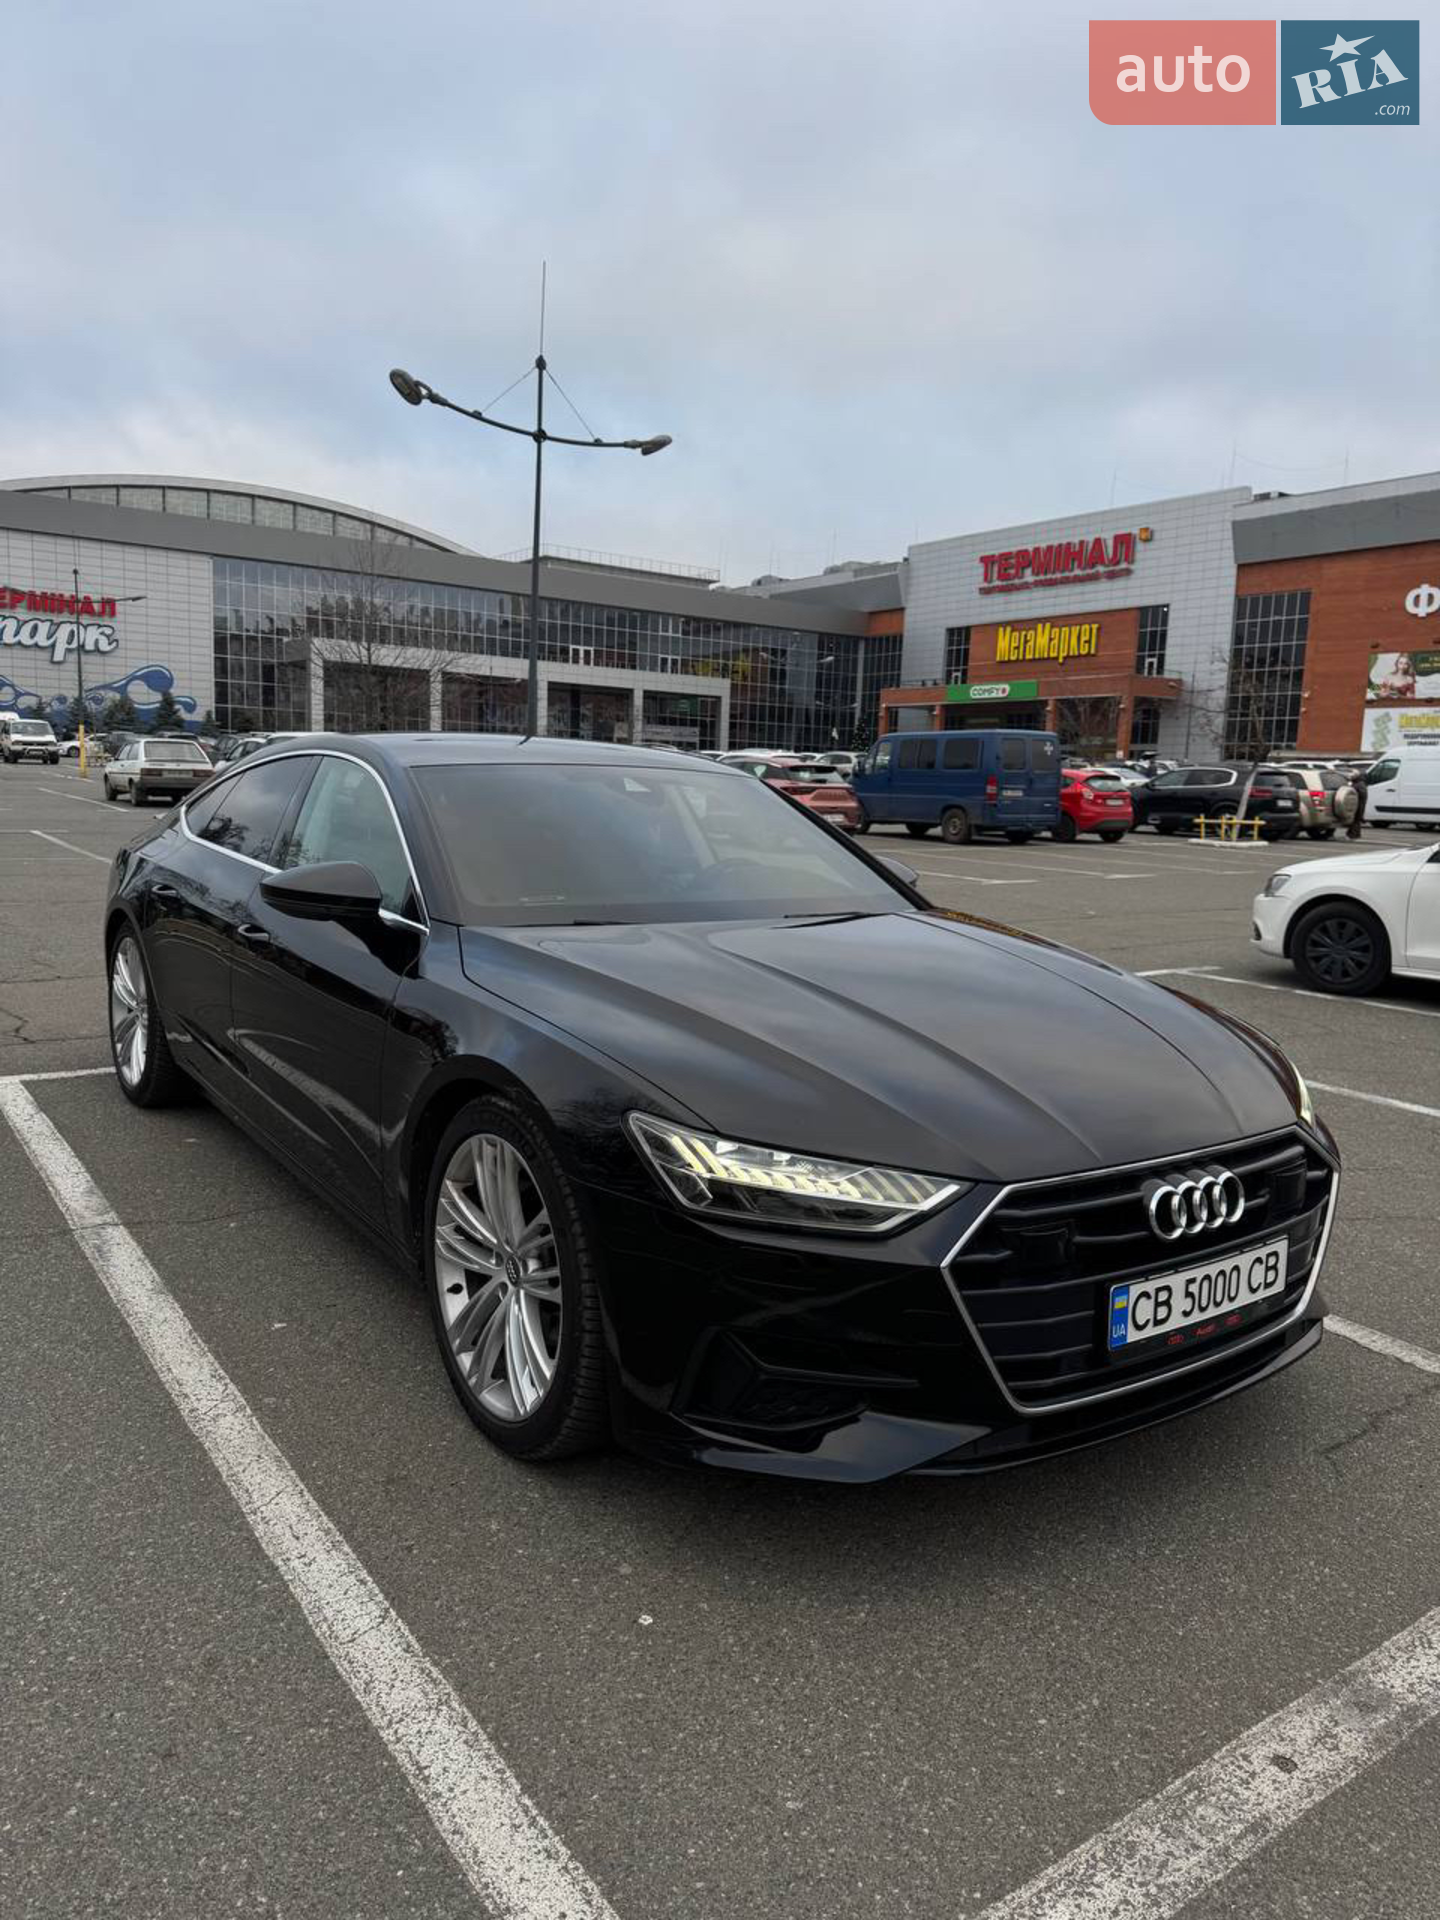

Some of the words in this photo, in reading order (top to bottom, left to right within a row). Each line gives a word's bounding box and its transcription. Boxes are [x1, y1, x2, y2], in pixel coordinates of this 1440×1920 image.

[979, 532, 1136, 583] ТЕРМІНАЛ
[996, 622, 1100, 664] МегаМаркет
[972, 686, 1000, 697] COMFY
[1131, 1285, 1173, 1332] CB
[1181, 1265, 1241, 1318] 5000
[1247, 1250, 1280, 1294] CB
[1112, 1323, 1126, 1338] UA
